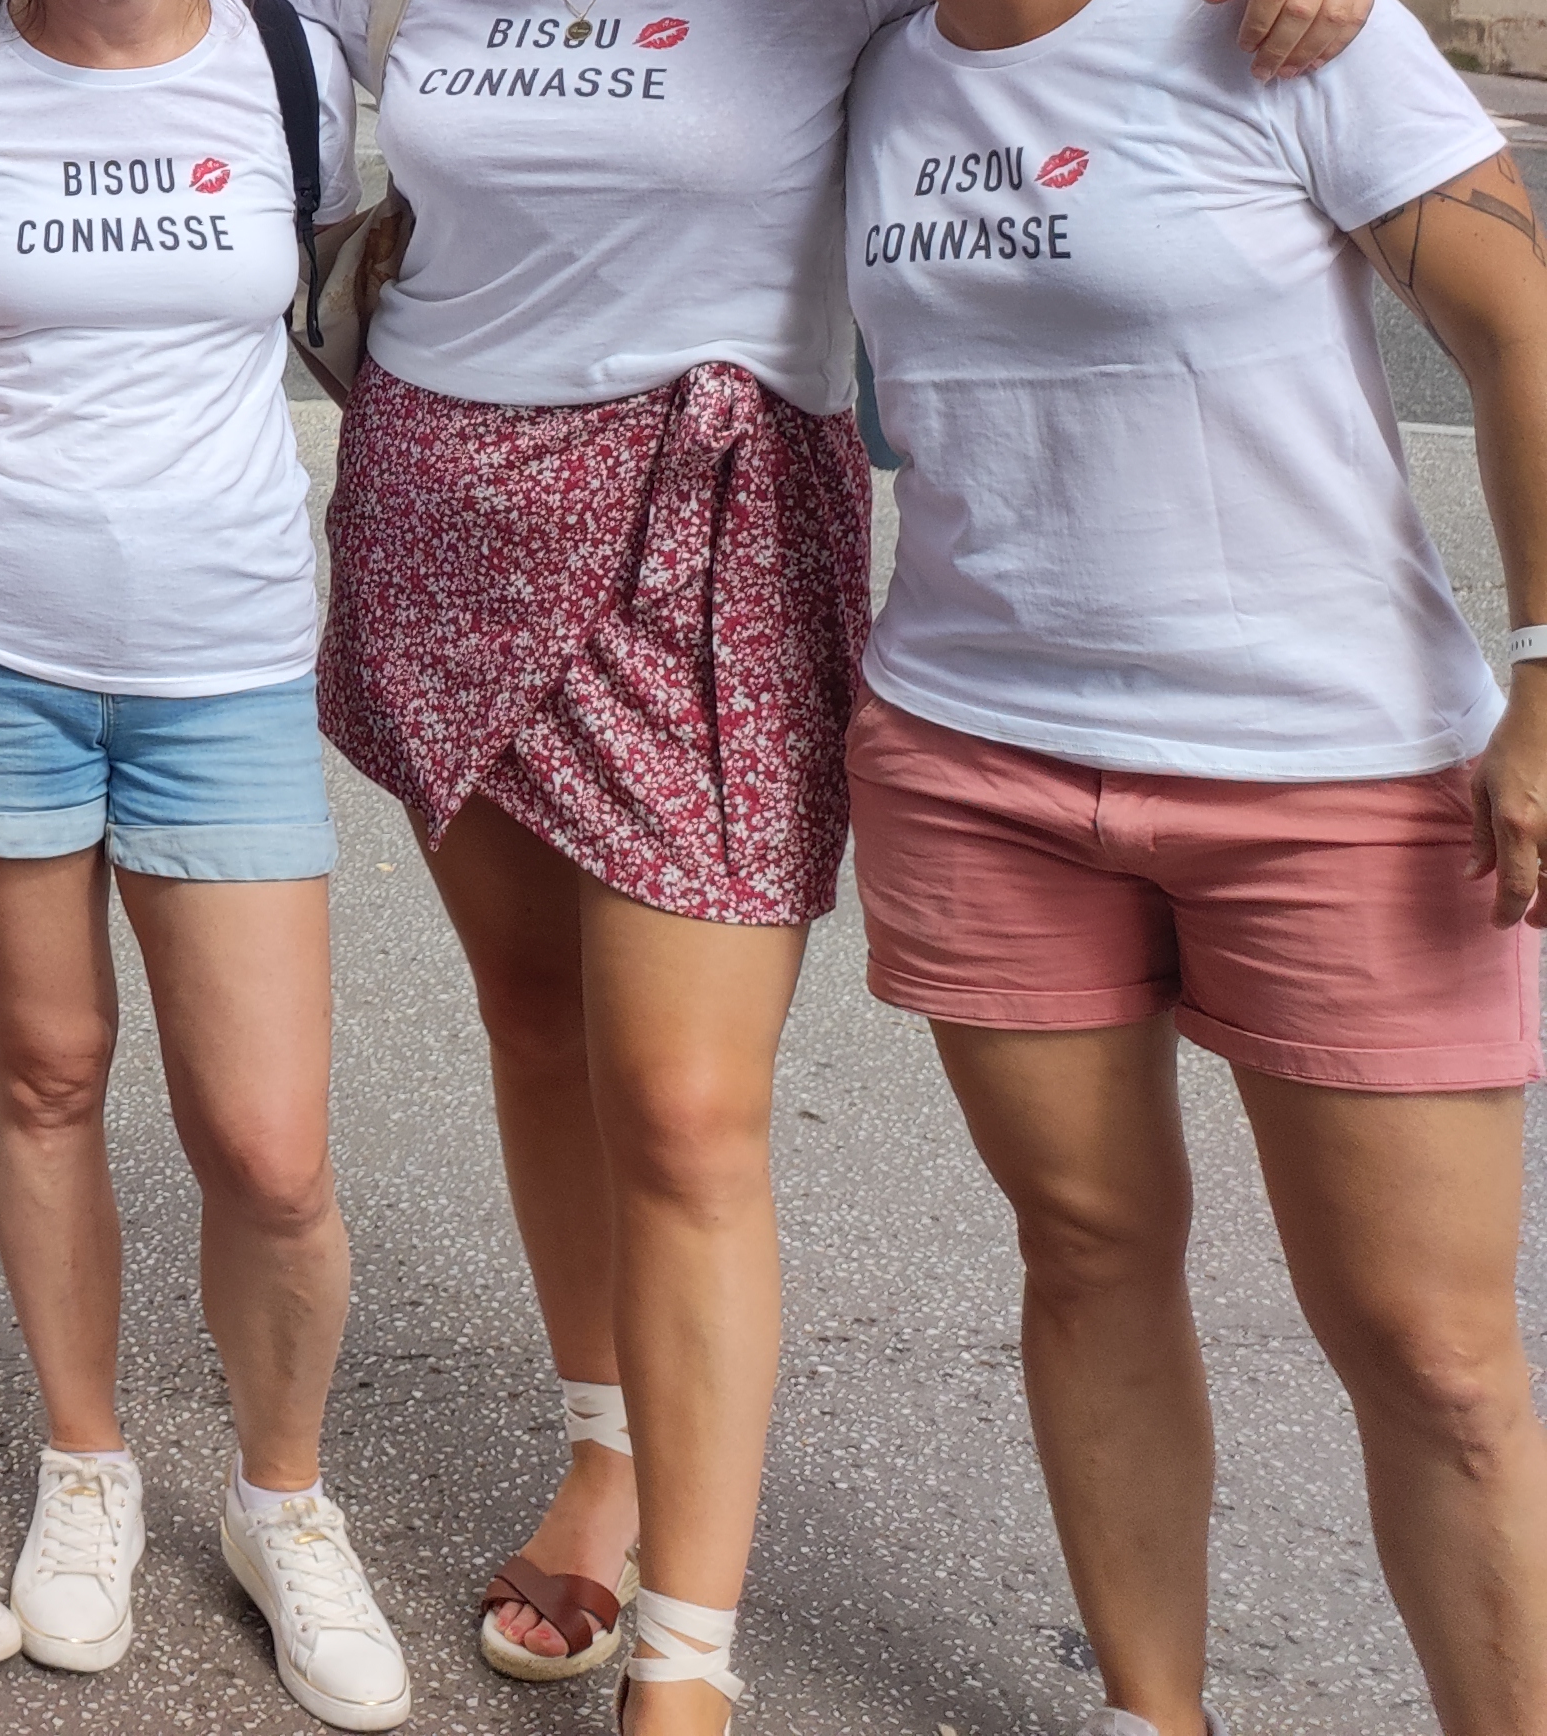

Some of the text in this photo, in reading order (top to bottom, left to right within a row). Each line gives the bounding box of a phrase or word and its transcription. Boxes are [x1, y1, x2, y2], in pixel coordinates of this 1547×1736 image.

[419, 67, 667, 100] CONNASSE
[63, 157, 175, 197] BISOU
[914, 146, 1024, 197] BISOU
[16, 215, 234, 255] CONNASSE
[864, 214, 1071, 267] CONNASSE
